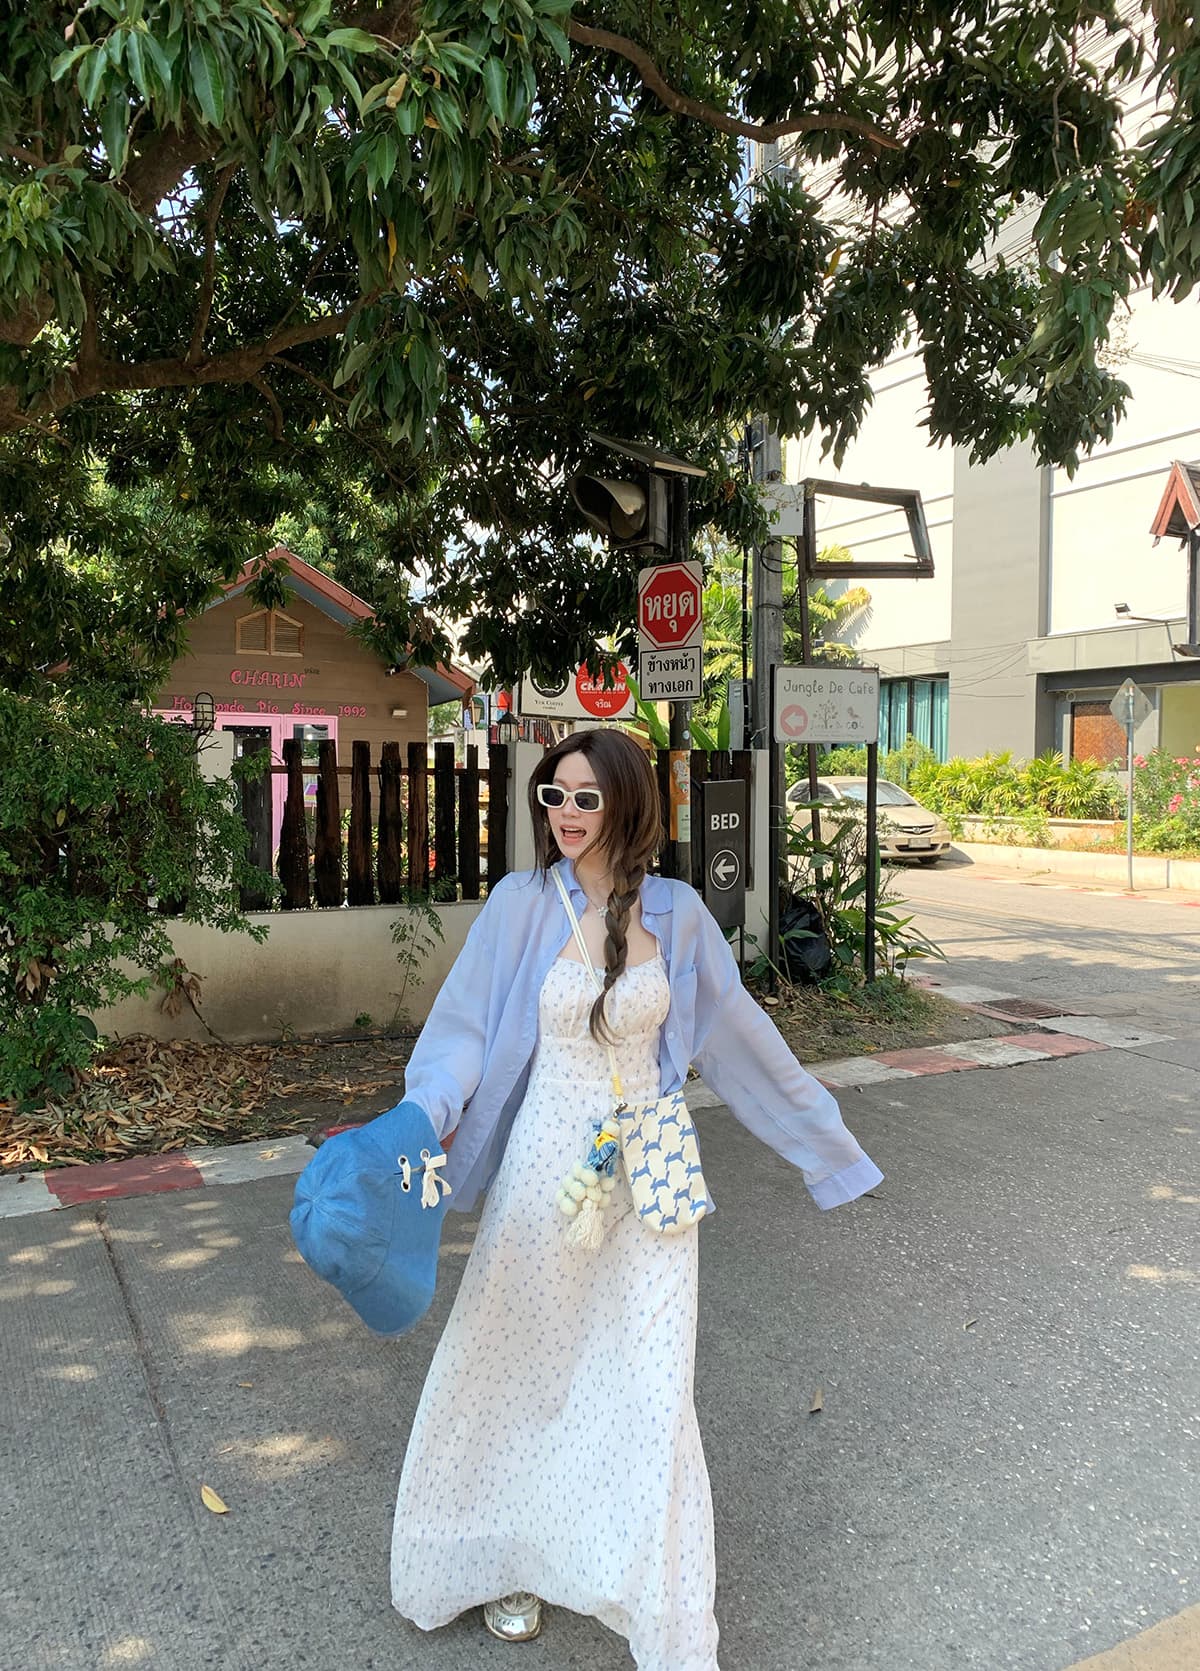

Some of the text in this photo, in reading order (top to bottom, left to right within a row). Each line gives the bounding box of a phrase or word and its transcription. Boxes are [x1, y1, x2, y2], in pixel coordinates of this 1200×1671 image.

[644, 590, 695, 633] หยุด
[647, 653, 695, 673] ข้างหน้า
[230, 669, 307, 689] CHARIN
[580, 682, 626, 691] CHAIN
[648, 679, 694, 694] ทางเอก
[783, 679, 874, 697] Jungle De Cafe
[173, 696, 367, 718] Homade Pie Since 1992
[711, 812, 740, 831] BED
